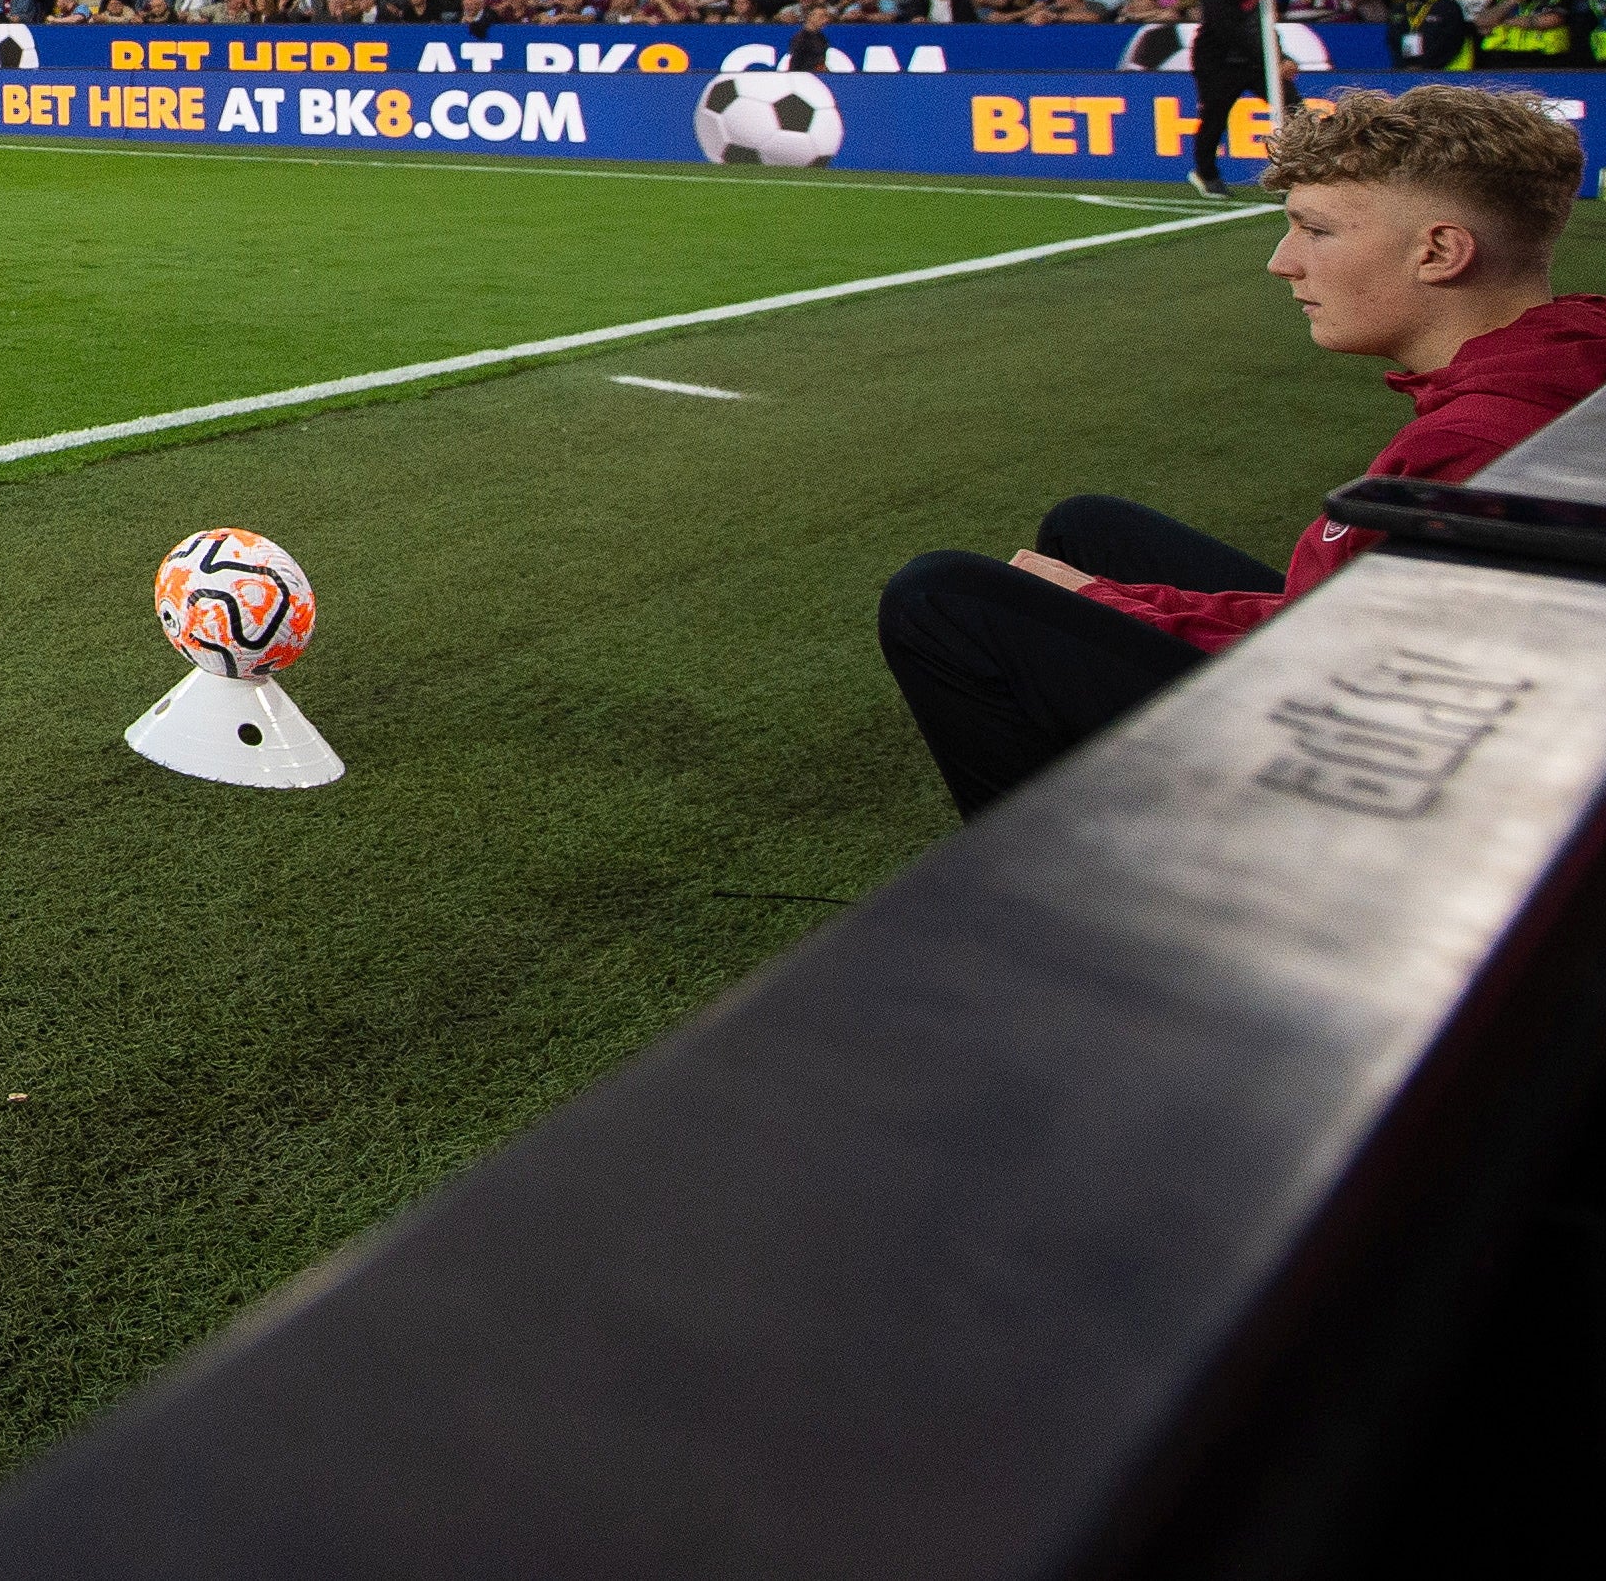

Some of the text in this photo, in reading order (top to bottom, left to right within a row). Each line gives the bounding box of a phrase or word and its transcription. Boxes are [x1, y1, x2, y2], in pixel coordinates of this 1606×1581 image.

[111, 41, 211, 70] BET
[229, 41, 389, 70] HERE
[417, 41, 503, 72] AT
[2, 84, 586, 143] BET HERE AT BK8.COM
[971, 96, 1126, 155] BET
